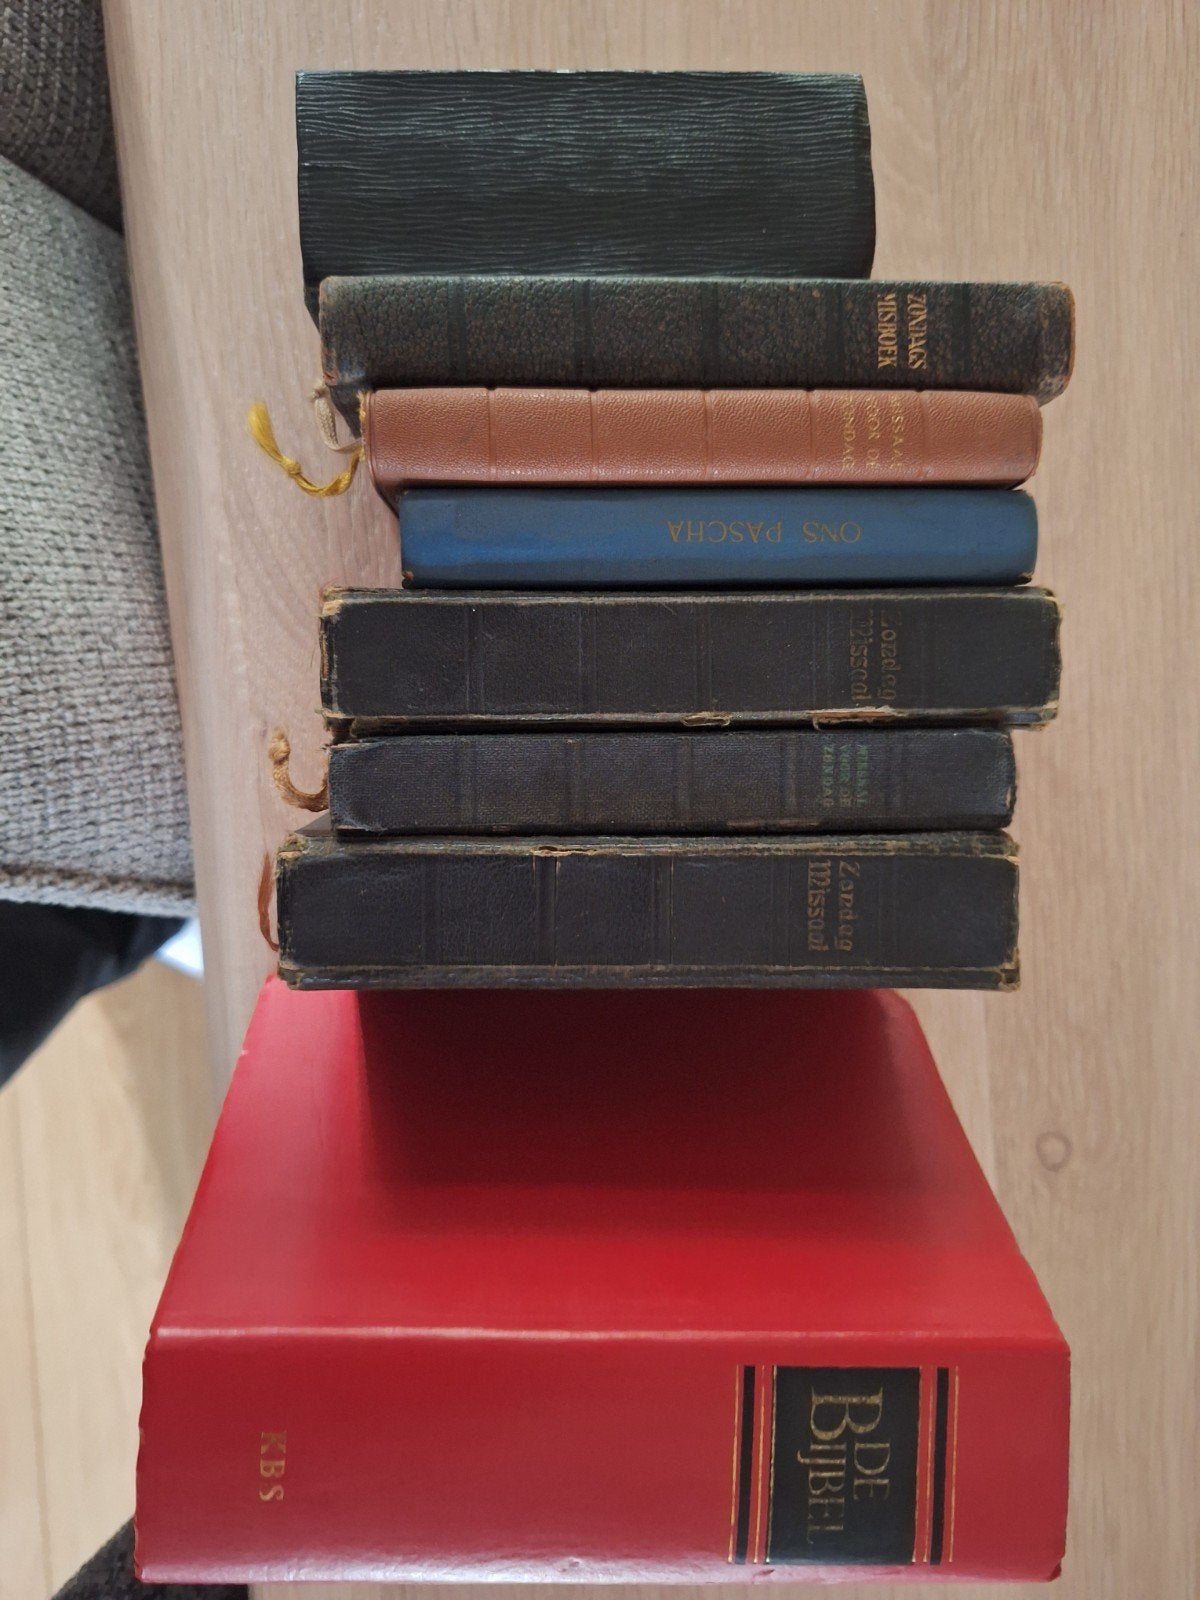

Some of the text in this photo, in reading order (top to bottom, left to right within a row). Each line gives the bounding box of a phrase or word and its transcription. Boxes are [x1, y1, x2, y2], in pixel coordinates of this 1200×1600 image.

[876, 291, 898, 369] MISBOEK
[906, 293, 929, 370] ZONDAGS
[666, 519, 863, 545] ONS PASCHA
[807, 859, 831, 952] Missaal
[833, 860, 860, 952] Zondag
[259, 1430, 287, 1502] KBS
[796, 1385, 884, 1544] BIJBEL
[853, 1439, 891, 1500] DE
